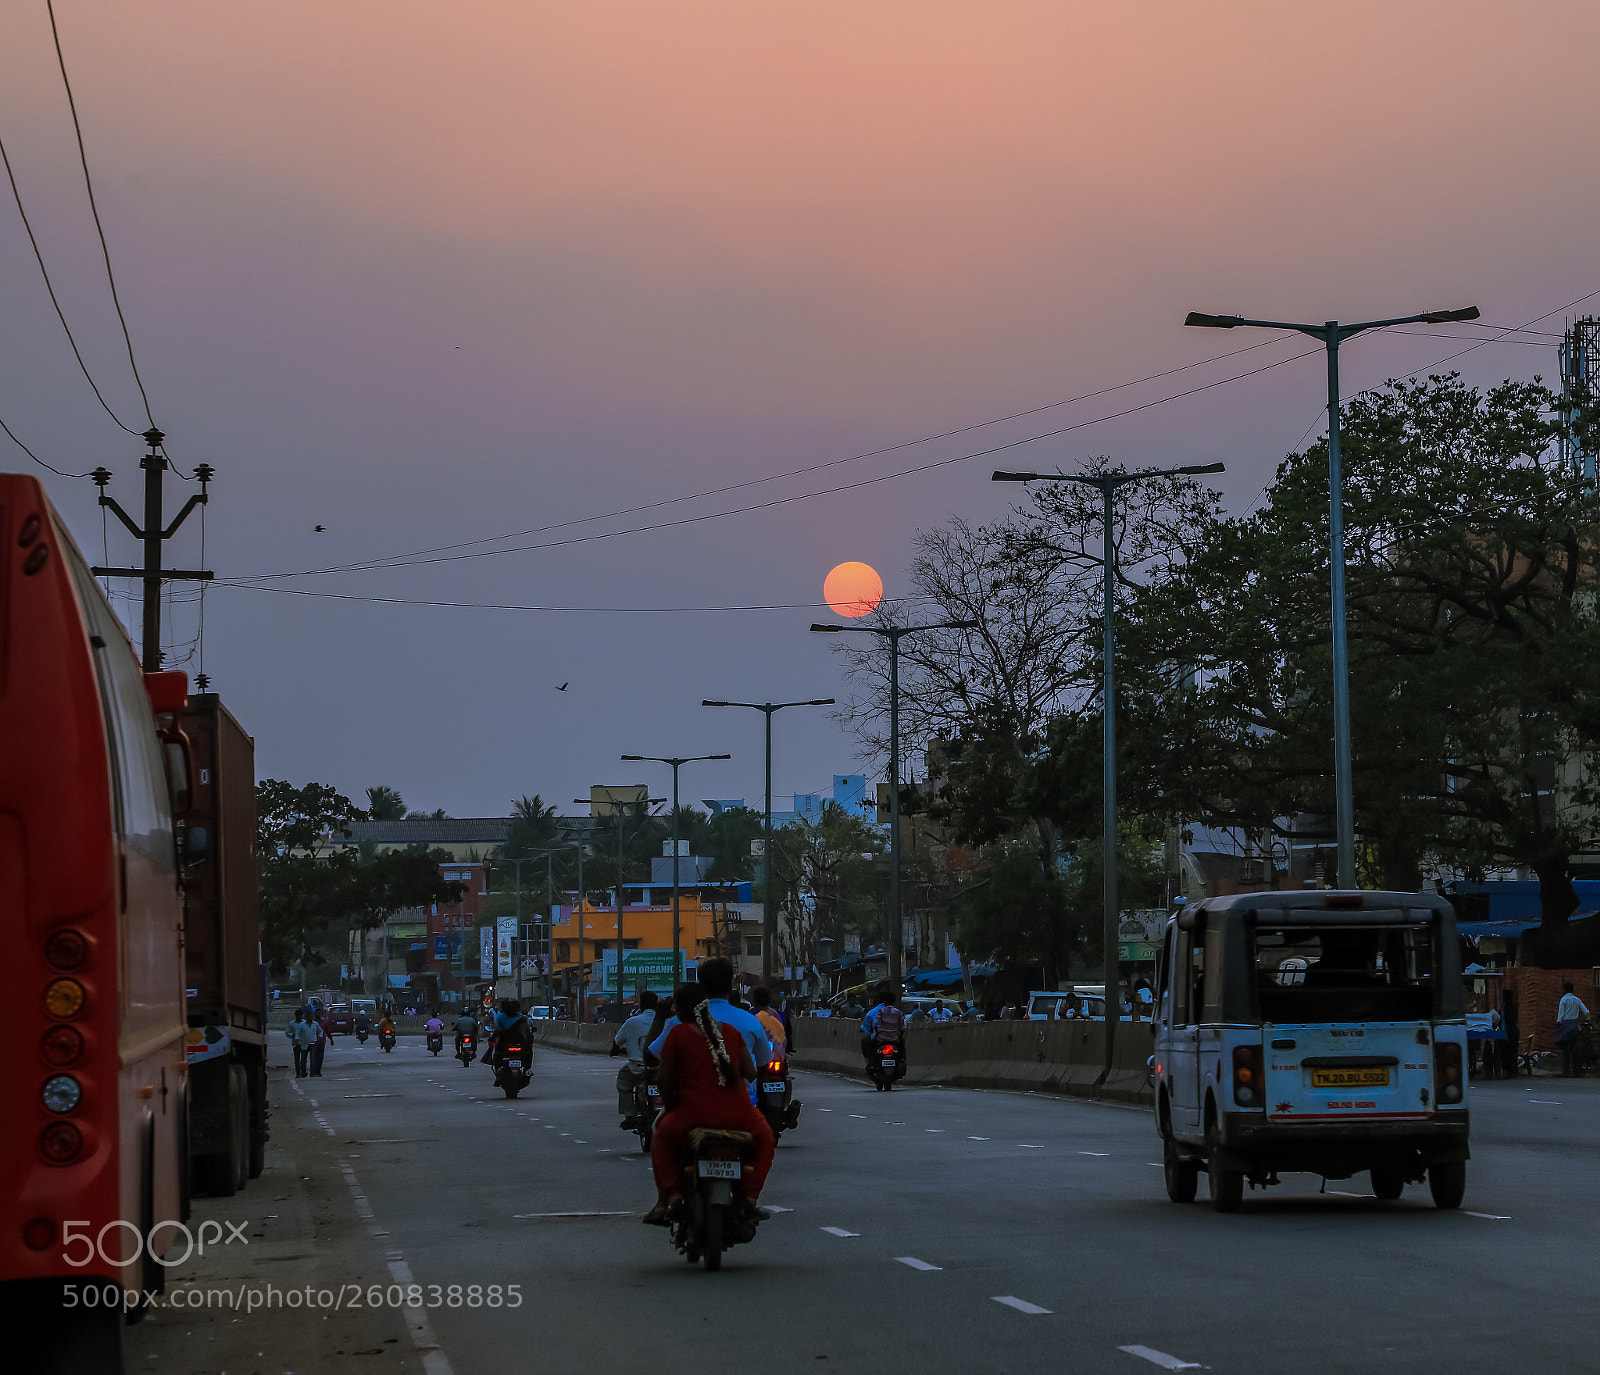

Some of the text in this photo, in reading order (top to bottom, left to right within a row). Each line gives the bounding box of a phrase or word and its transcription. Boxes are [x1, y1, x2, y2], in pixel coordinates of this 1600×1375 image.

[608, 965, 637, 974] NAAM
[1327, 1101, 1376, 1109] SOUND HORN
